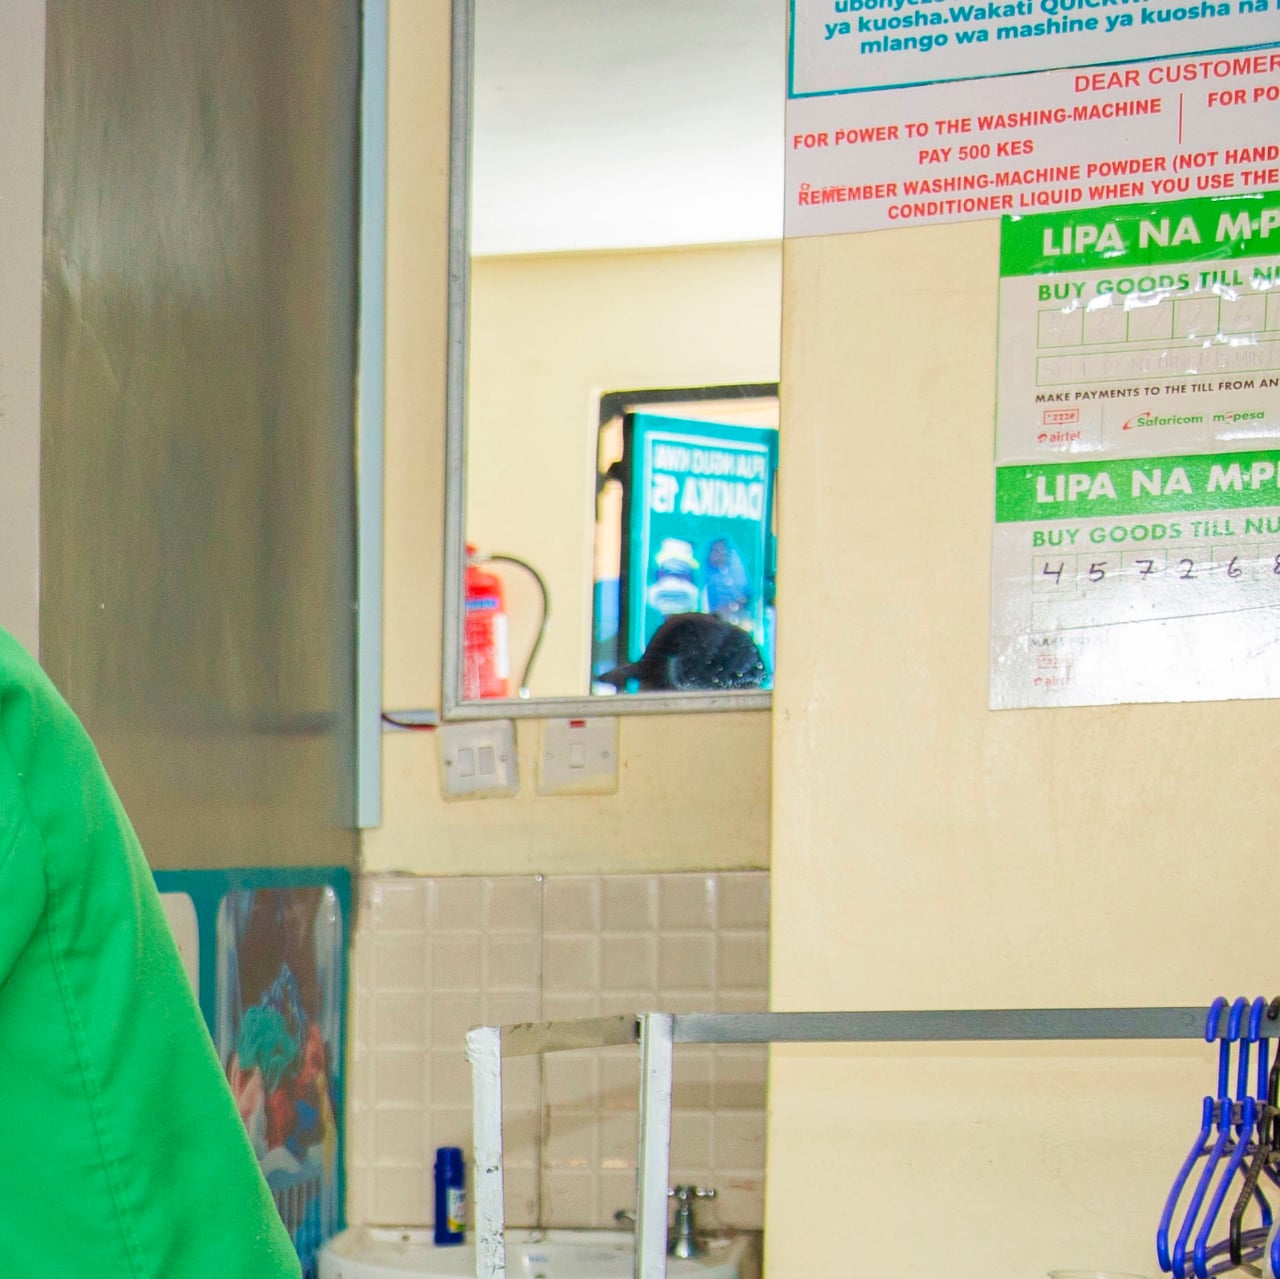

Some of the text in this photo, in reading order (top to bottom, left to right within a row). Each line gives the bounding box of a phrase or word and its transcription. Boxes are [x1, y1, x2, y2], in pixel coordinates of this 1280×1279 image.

[824, 21, 851, 40] ya
[860, 33, 948, 54] mlango
[955, 29, 989, 44] wa
[996, 16, 1099, 40] mashine
[1105, 13, 1133, 33] ya
[1140, 1, 1230, 25] kuosha
[1074, 69, 1141, 93] DEAR
[1208, 89, 1247, 107] FOR
[793, 98, 1162, 149] FOR POWER TO THE WASHING-MACHINE
[918, 139, 1034, 165] PAY 500 KES
[798, 145, 1280, 206] REMEMBER WASHING-MACHINE POWDER (NOT HAND
[887, 168, 1280, 220] CONDITIONER LIQUID WHEN YOU USE THE
[1042, 222, 1125, 257] LIPA
[1139, 215, 1201, 248] NA
[1038, 281, 1087, 302] BUY
[1095, 273, 1190, 296] GOODS
[1199, 270, 1244, 290] TILL
[1035, 391, 1071, 404] MAKE
[1074, 387, 1140, 401] PAYMENTS
[1144, 386, 1161, 396] TO
[1165, 384, 1187, 394] THE
[1191, 382, 1214, 393] TILL
[1218, 379, 1255, 391] FROM
[1137, 414, 1203, 428] Safaricom
[1049, 430, 1081, 444] airtel
[1036, 471, 1118, 504] LIPA
[1131, 466, 1193, 498] NA
[1032, 528, 1080, 548] BUY
[1089, 522, 1183, 544] GOODS
[1190, 519, 1235, 538] TILL
[1042, 561, 1065, 585] 4
[1089, 561, 1107, 583] 5
[1135, 559, 1155, 580] 7
[1179, 558, 1198, 580] 2
[1226, 555, 1243, 578] 6
